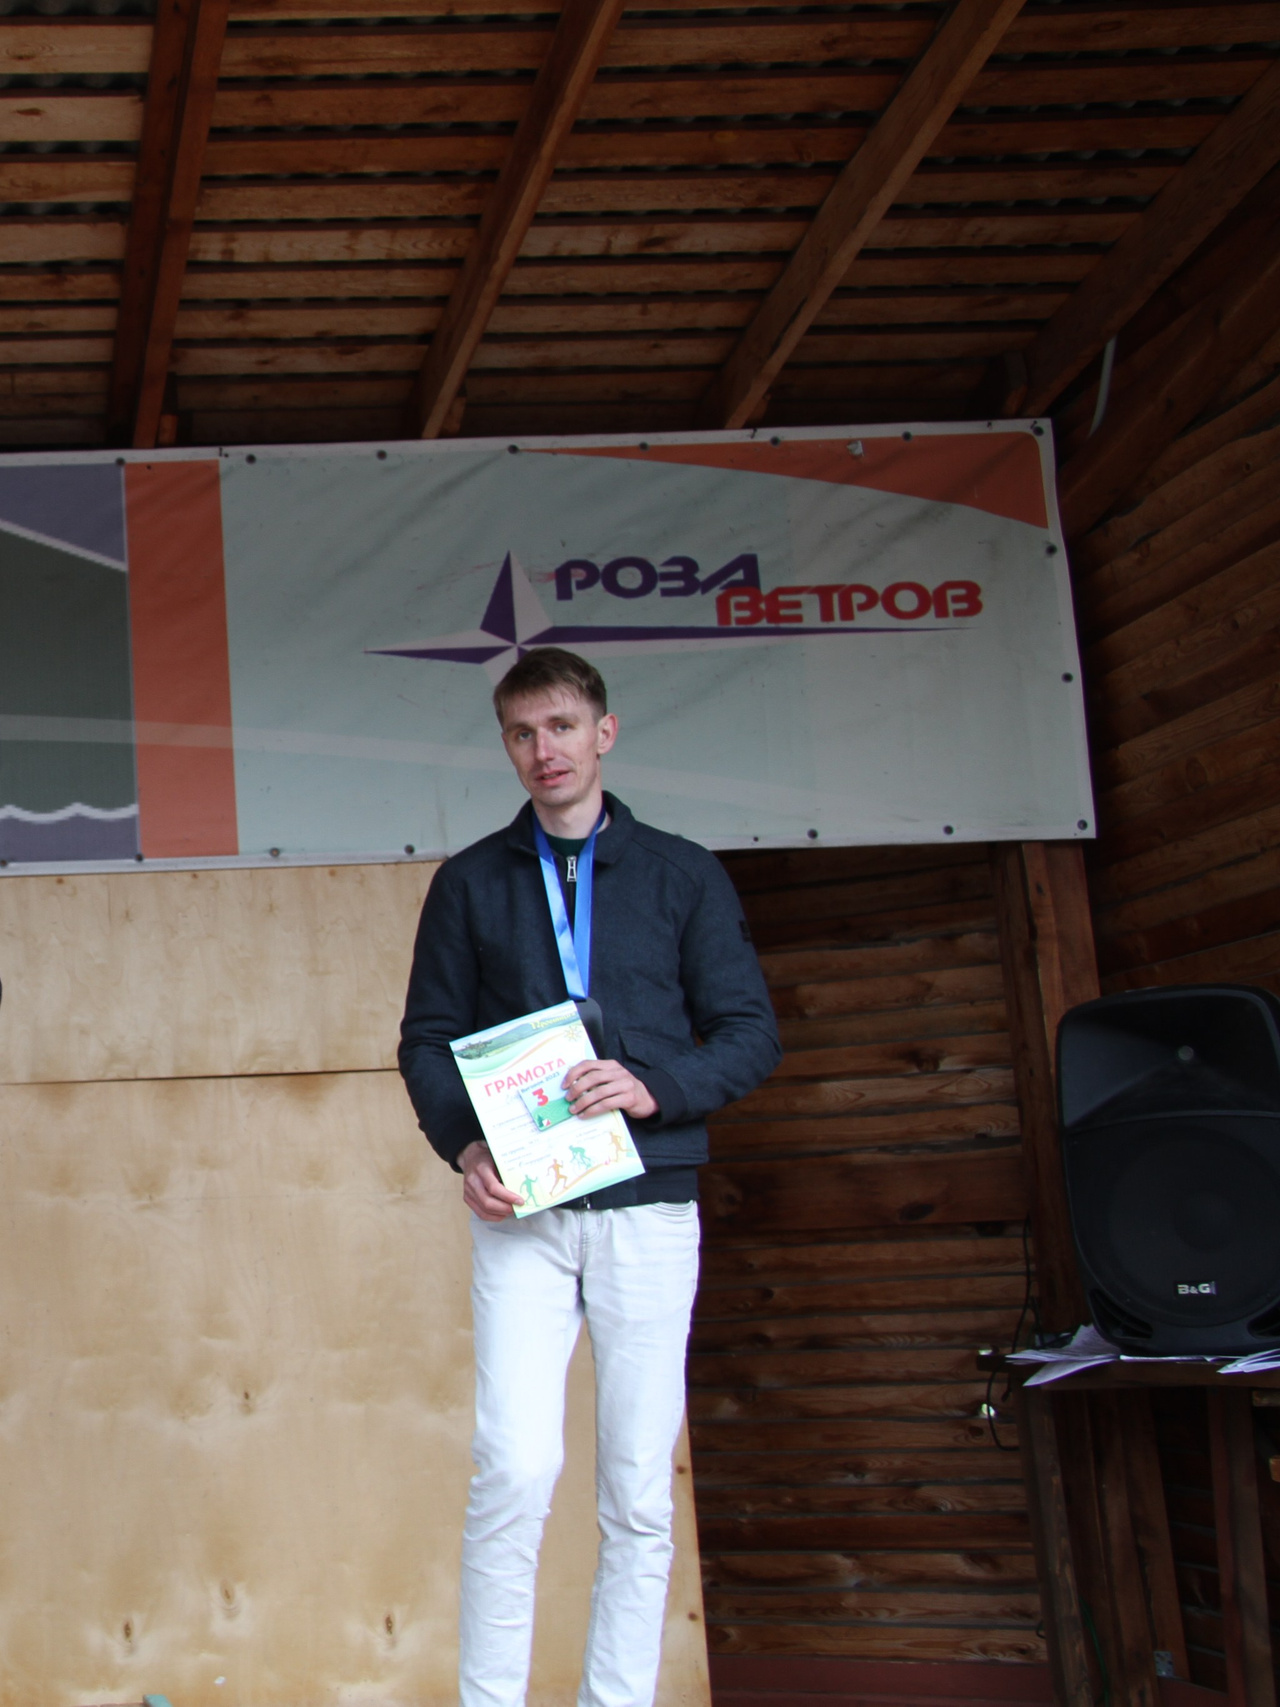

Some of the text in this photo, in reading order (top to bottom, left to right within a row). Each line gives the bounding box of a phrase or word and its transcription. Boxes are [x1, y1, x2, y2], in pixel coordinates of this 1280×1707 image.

[555, 553, 761, 601] РОЗА
[716, 580, 983, 626] ВЕТРОВ
[484, 1058, 566, 1097] ГРАМОТА
[532, 1087, 549, 1107] 3
[1177, 1283, 1211, 1295] B&G
